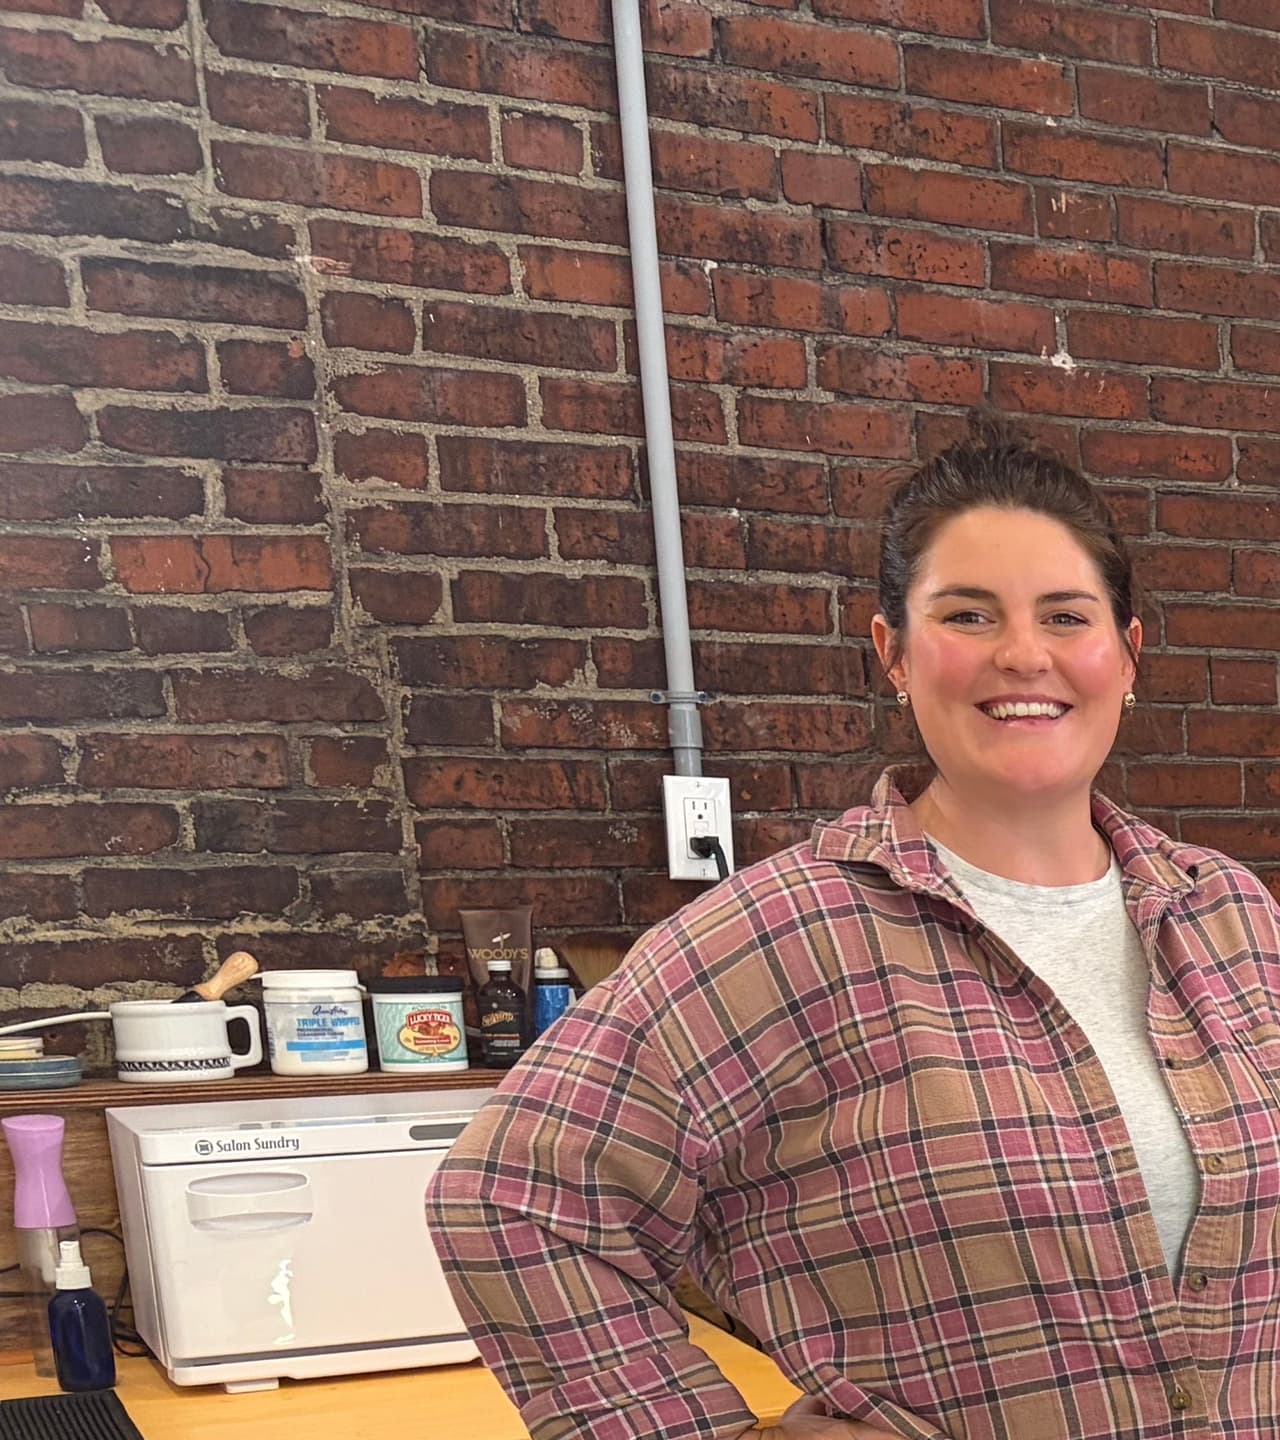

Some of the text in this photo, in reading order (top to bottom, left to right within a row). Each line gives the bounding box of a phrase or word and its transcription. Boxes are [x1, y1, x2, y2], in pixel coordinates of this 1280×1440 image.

[468, 948, 529, 960] WOODY'S
[216, 1135, 300, 1152] Salon Sundry
